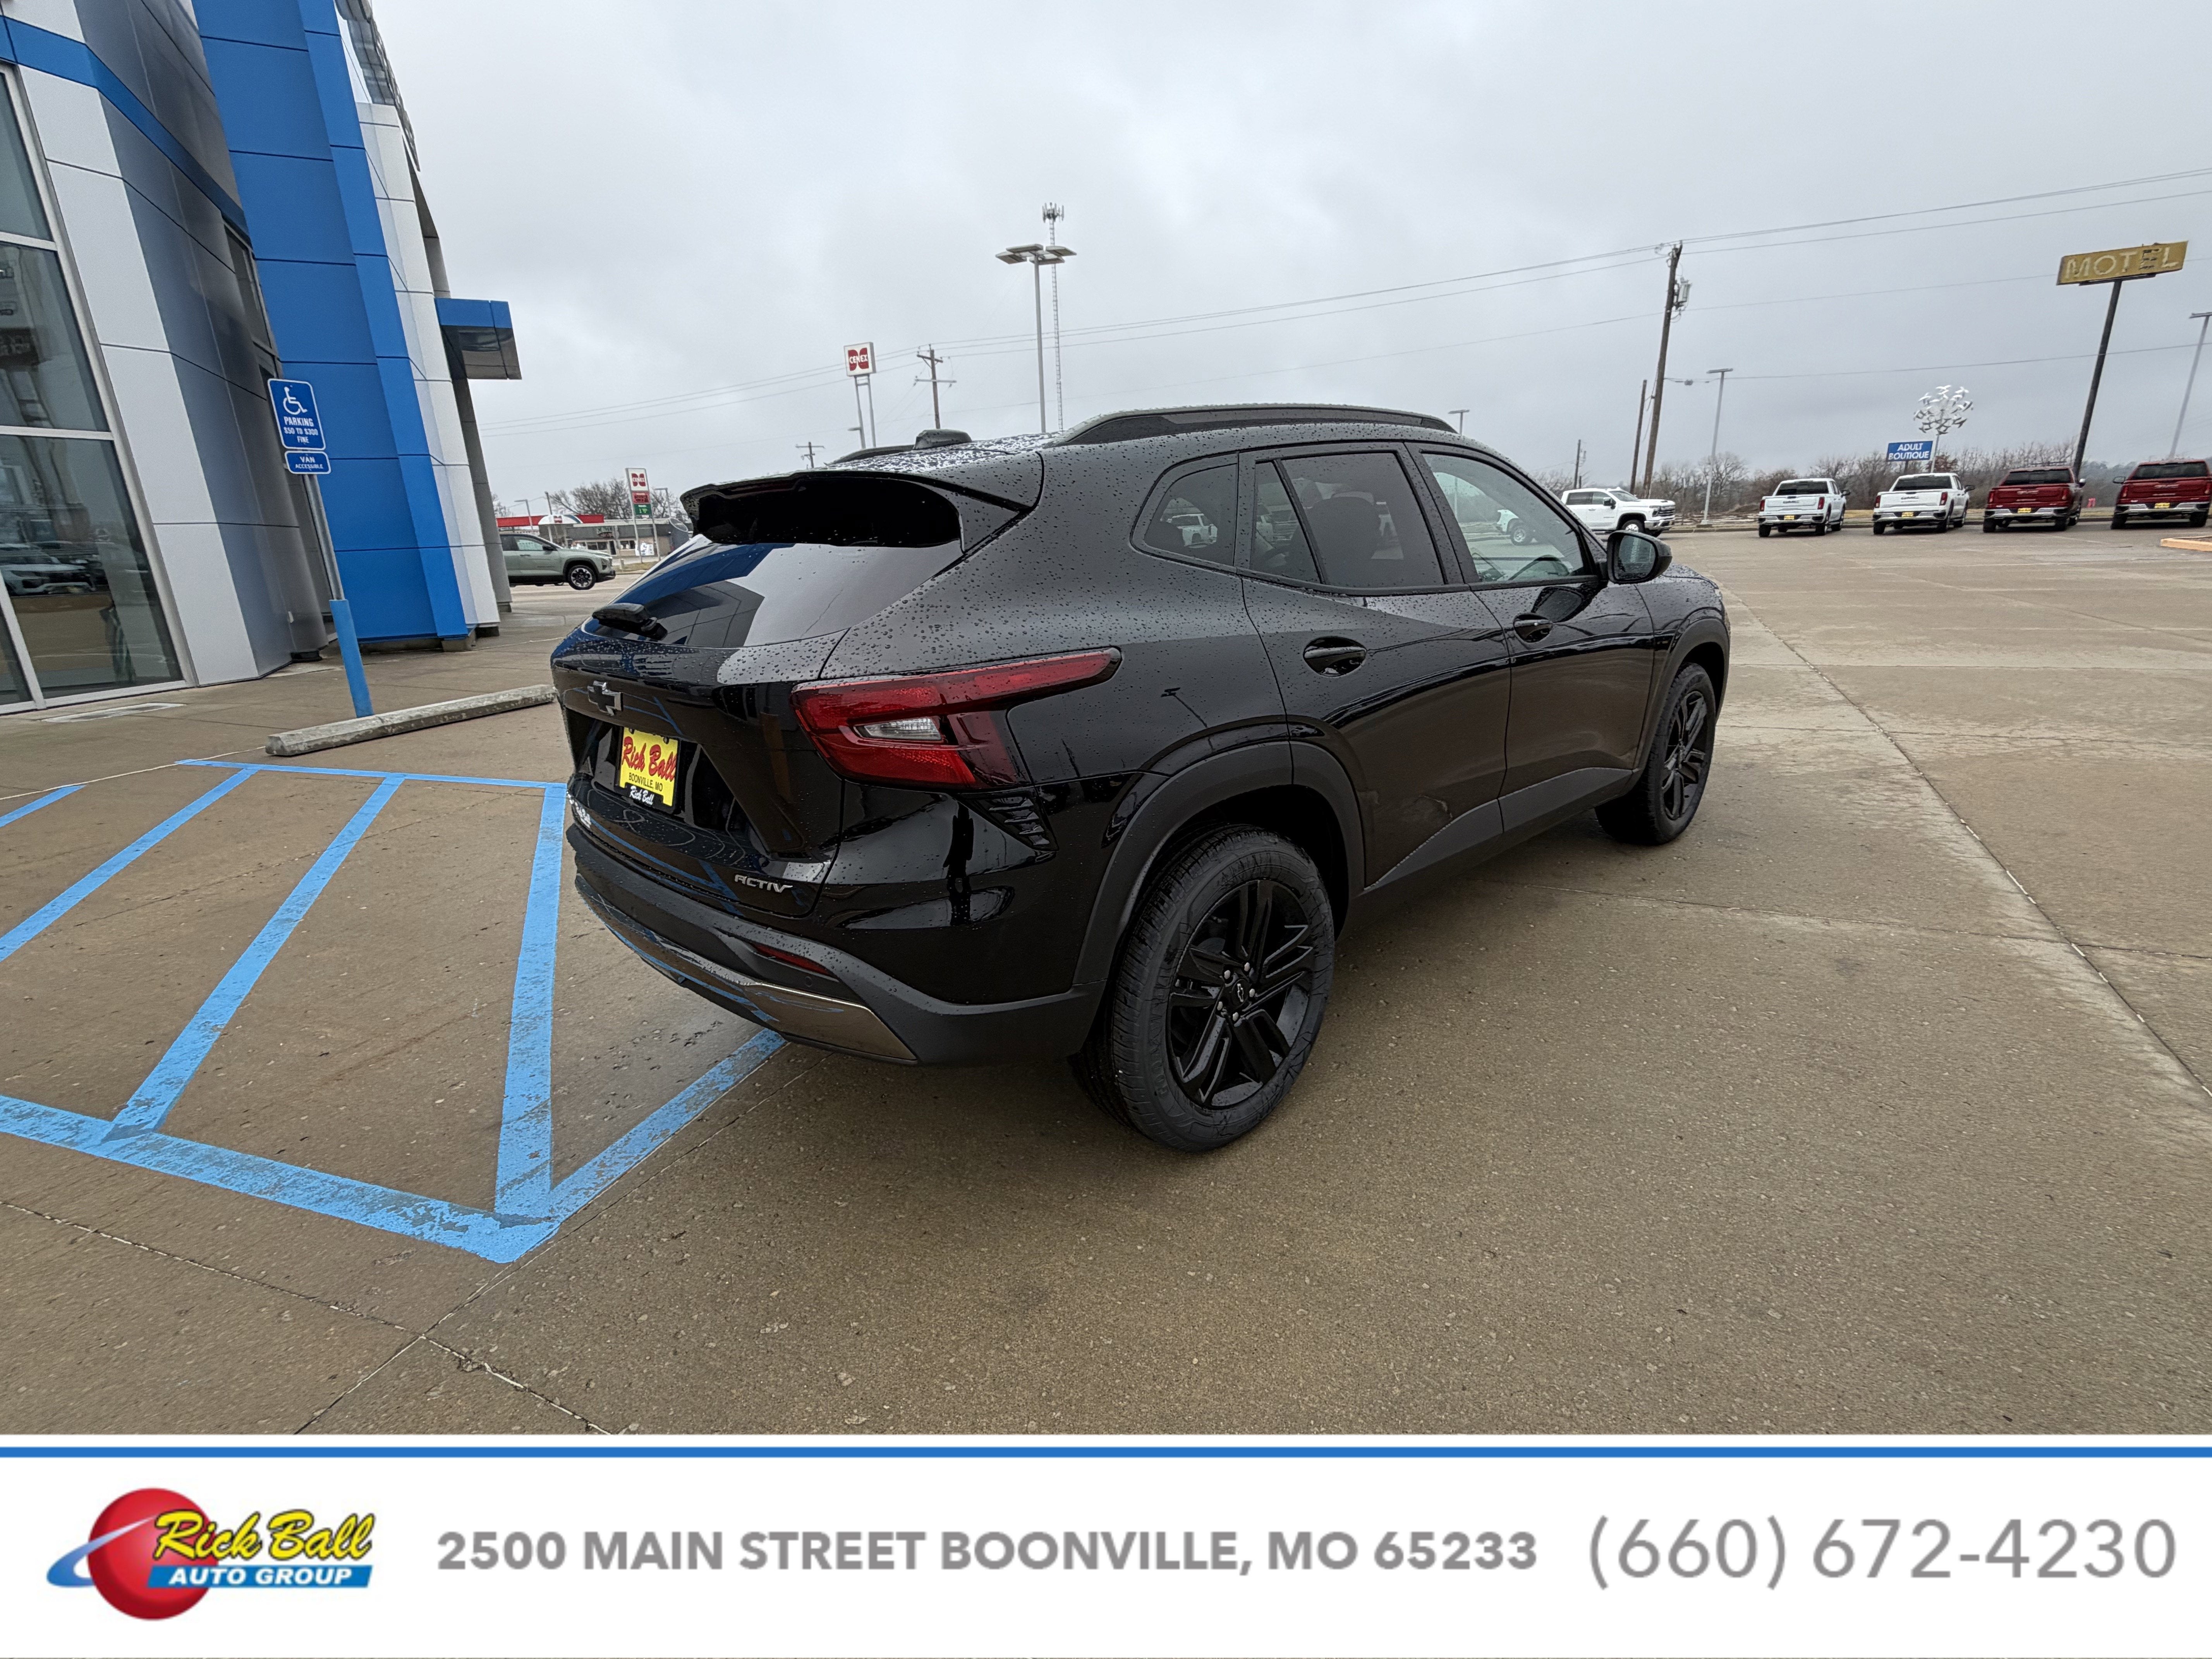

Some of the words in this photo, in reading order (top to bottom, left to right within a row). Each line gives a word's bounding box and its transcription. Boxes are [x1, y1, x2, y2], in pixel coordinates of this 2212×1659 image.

[2064, 247, 2179, 279] MOTEL
[849, 354, 868, 364] CENEX
[283, 416, 314, 427] PARKING
[1897, 443, 1923, 451] ADULT
[1888, 451, 1930, 460] BOUTIQUE
[622, 736, 646, 772] Rick
[649, 744, 677, 782] Ball
[654, 782, 663, 792] MO
[629, 785, 642, 801] Rick
[642, 790, 654, 805] Ball
[734, 874, 793, 893] ACTIV
